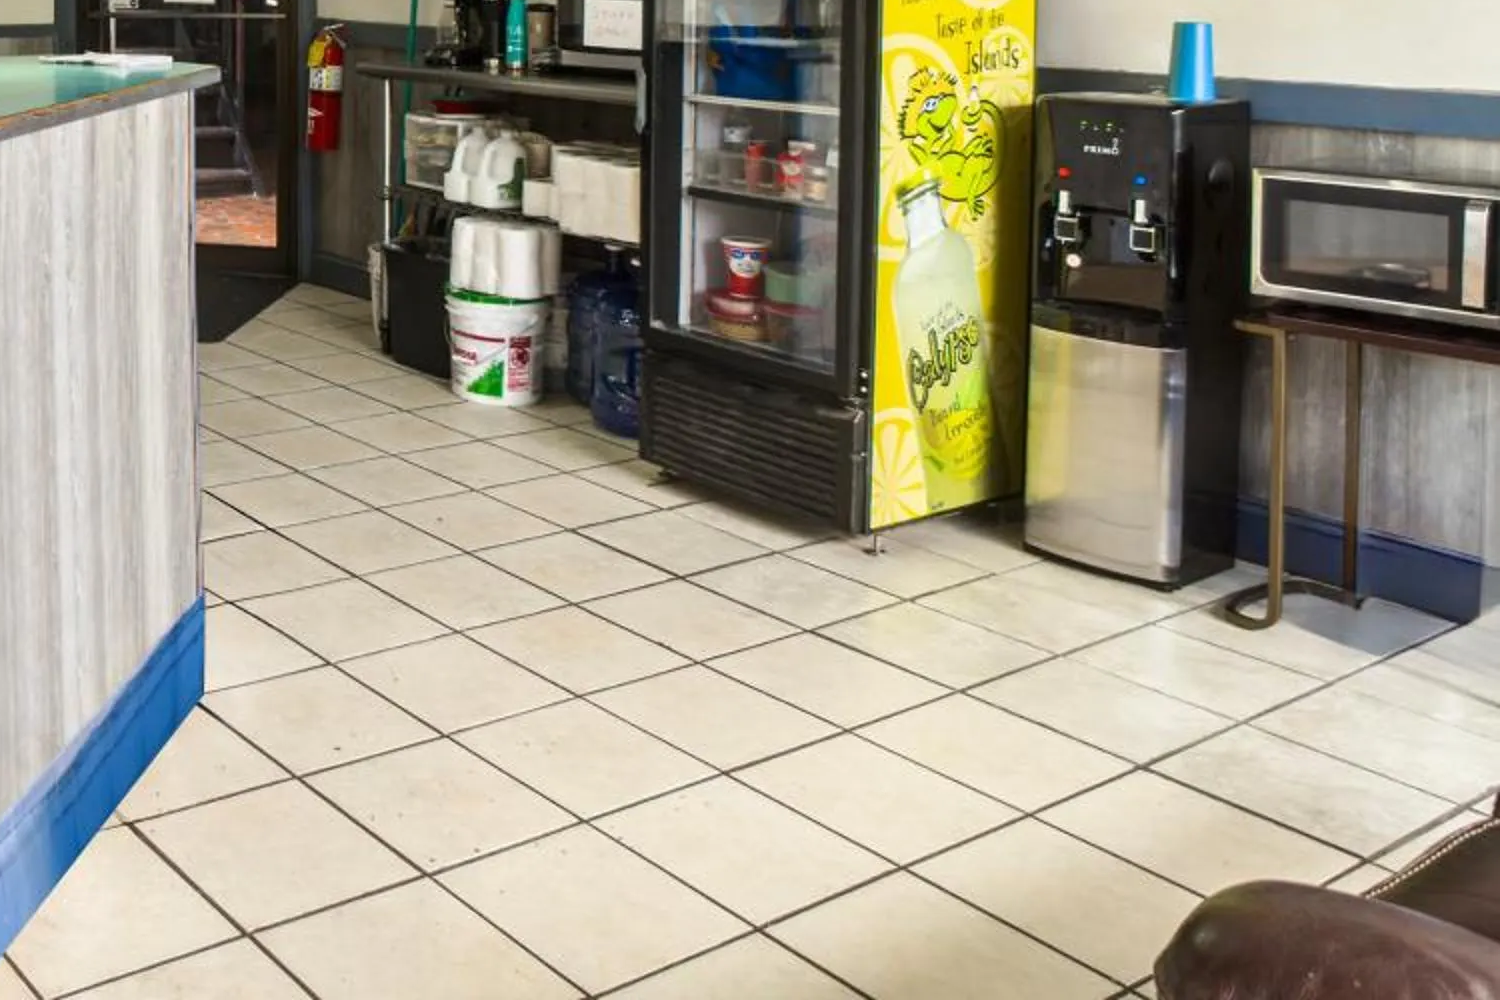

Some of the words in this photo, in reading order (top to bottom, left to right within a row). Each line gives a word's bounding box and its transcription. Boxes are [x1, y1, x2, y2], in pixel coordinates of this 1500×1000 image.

[936, 12, 967, 39] Taste
[963, 37, 1020, 75] Islands
[908, 317, 981, 415] Calypso
